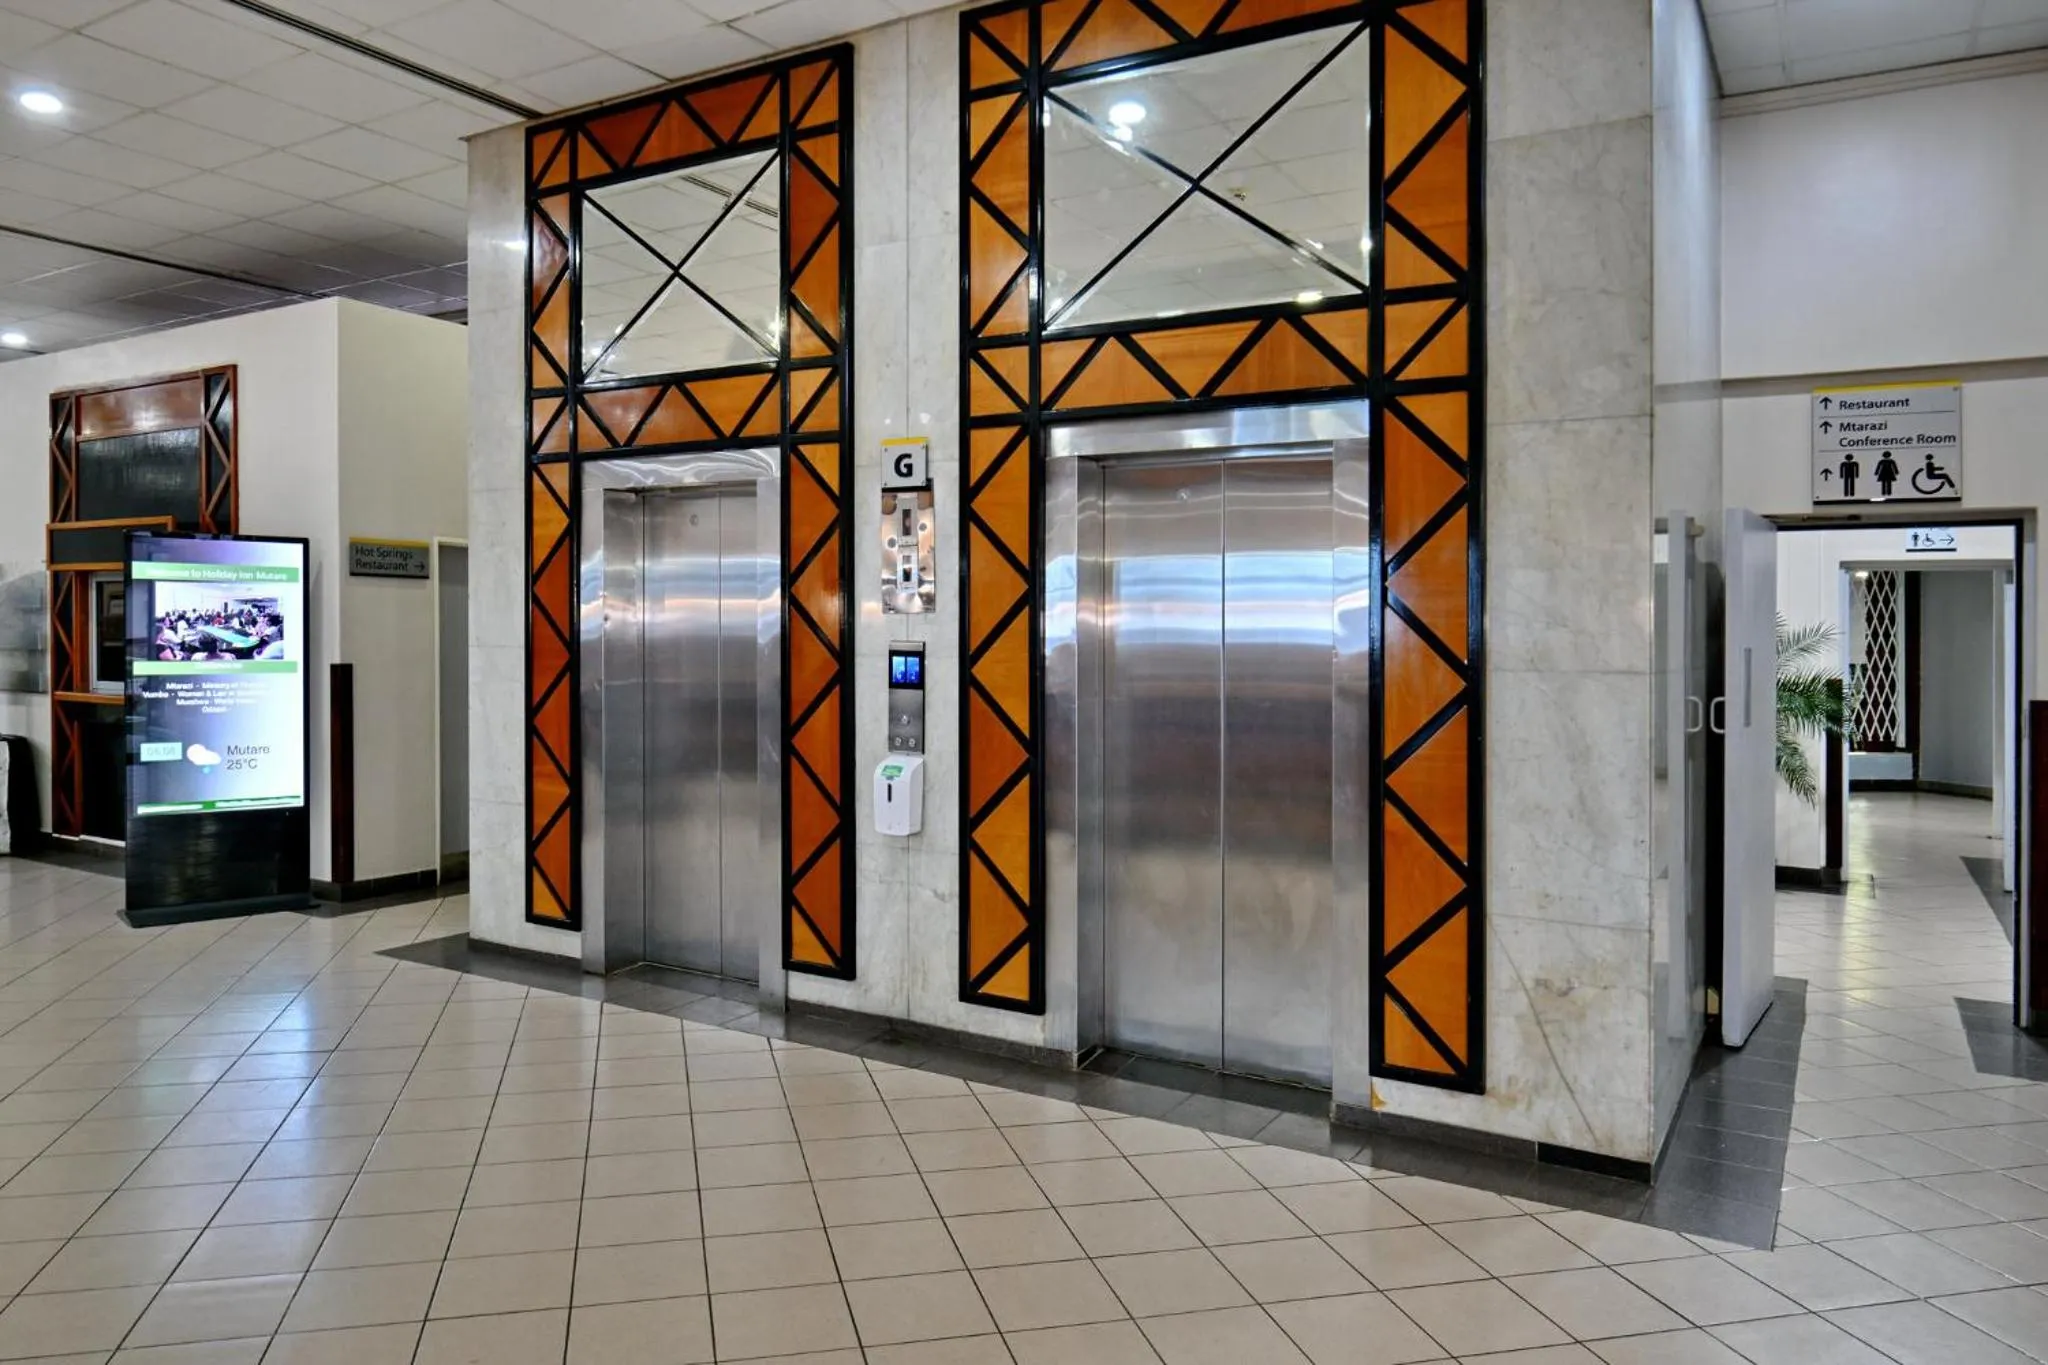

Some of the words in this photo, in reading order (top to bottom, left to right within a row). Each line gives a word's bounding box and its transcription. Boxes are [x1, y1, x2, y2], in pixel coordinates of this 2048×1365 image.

[1838, 398, 1910, 410] Restaurant
[1838, 420, 1888, 432] Mtarazi
[1838, 434, 1913, 448] Conference
[1916, 433, 1957, 445] Room
[894, 453, 914, 478] G
[354, 545, 374, 557] Hot
[376, 546, 413, 562] Springs
[355, 558, 409, 571] Restaurant
[227, 745, 270, 756] Mutare
[226, 758, 258, 770] 25°C
